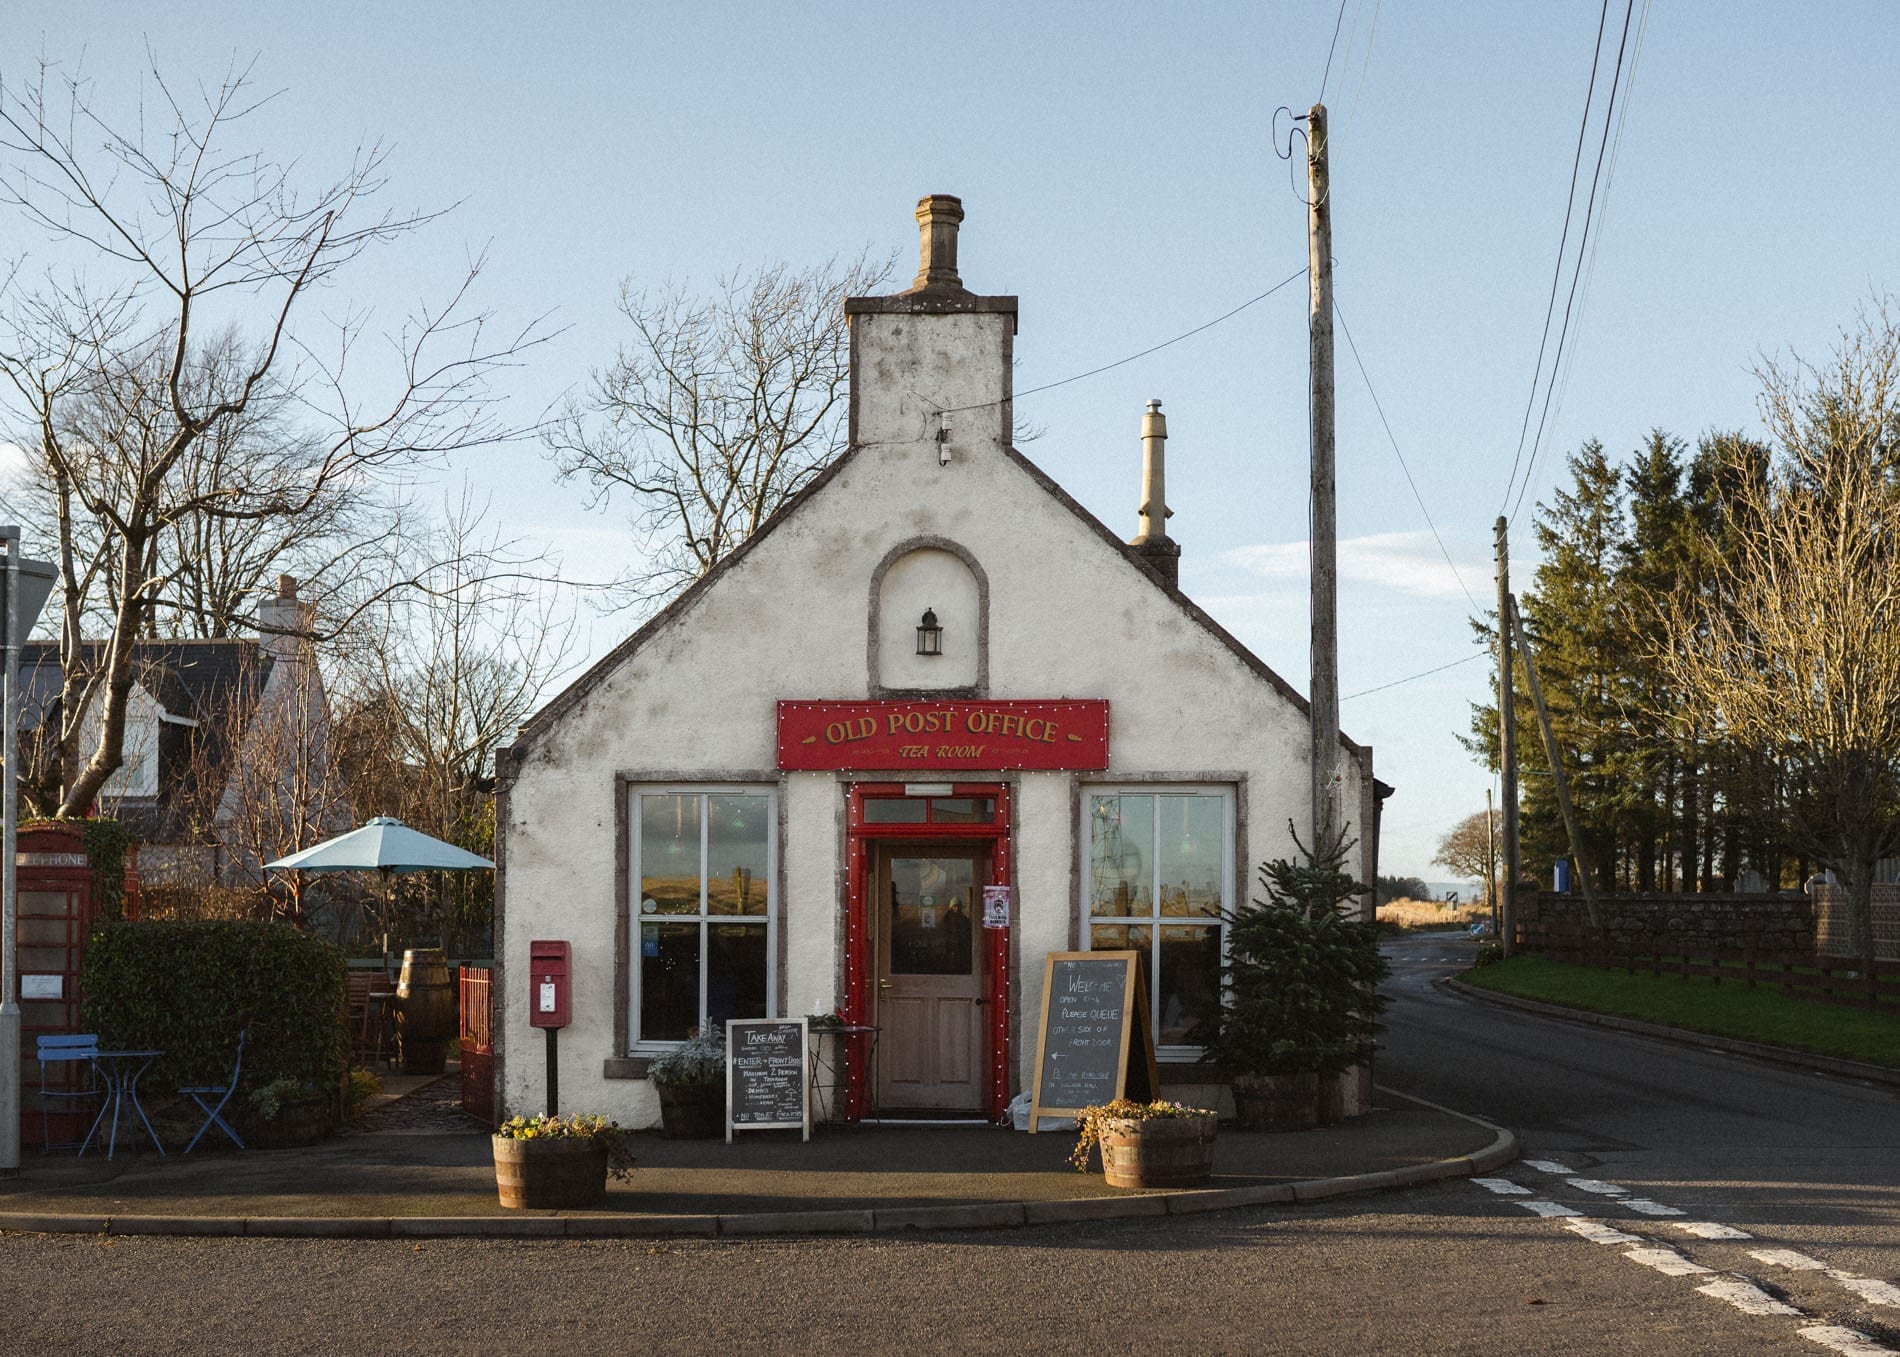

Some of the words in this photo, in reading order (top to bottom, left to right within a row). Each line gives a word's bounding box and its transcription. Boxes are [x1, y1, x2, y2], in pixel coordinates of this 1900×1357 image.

[826, 717, 878, 744] OLD
[887, 711, 958, 735] POST
[967, 711, 1059, 744] OFFICE
[900, 745, 928, 758] TEA
[936, 745, 985, 758] ROOM
[1068, 975, 1113, 993] WELCME
[1062, 1007, 1088, 1019] PLEASE
[1090, 1008, 1119, 1021] QUEUE
[738, 1056, 762, 1066] ENTER
